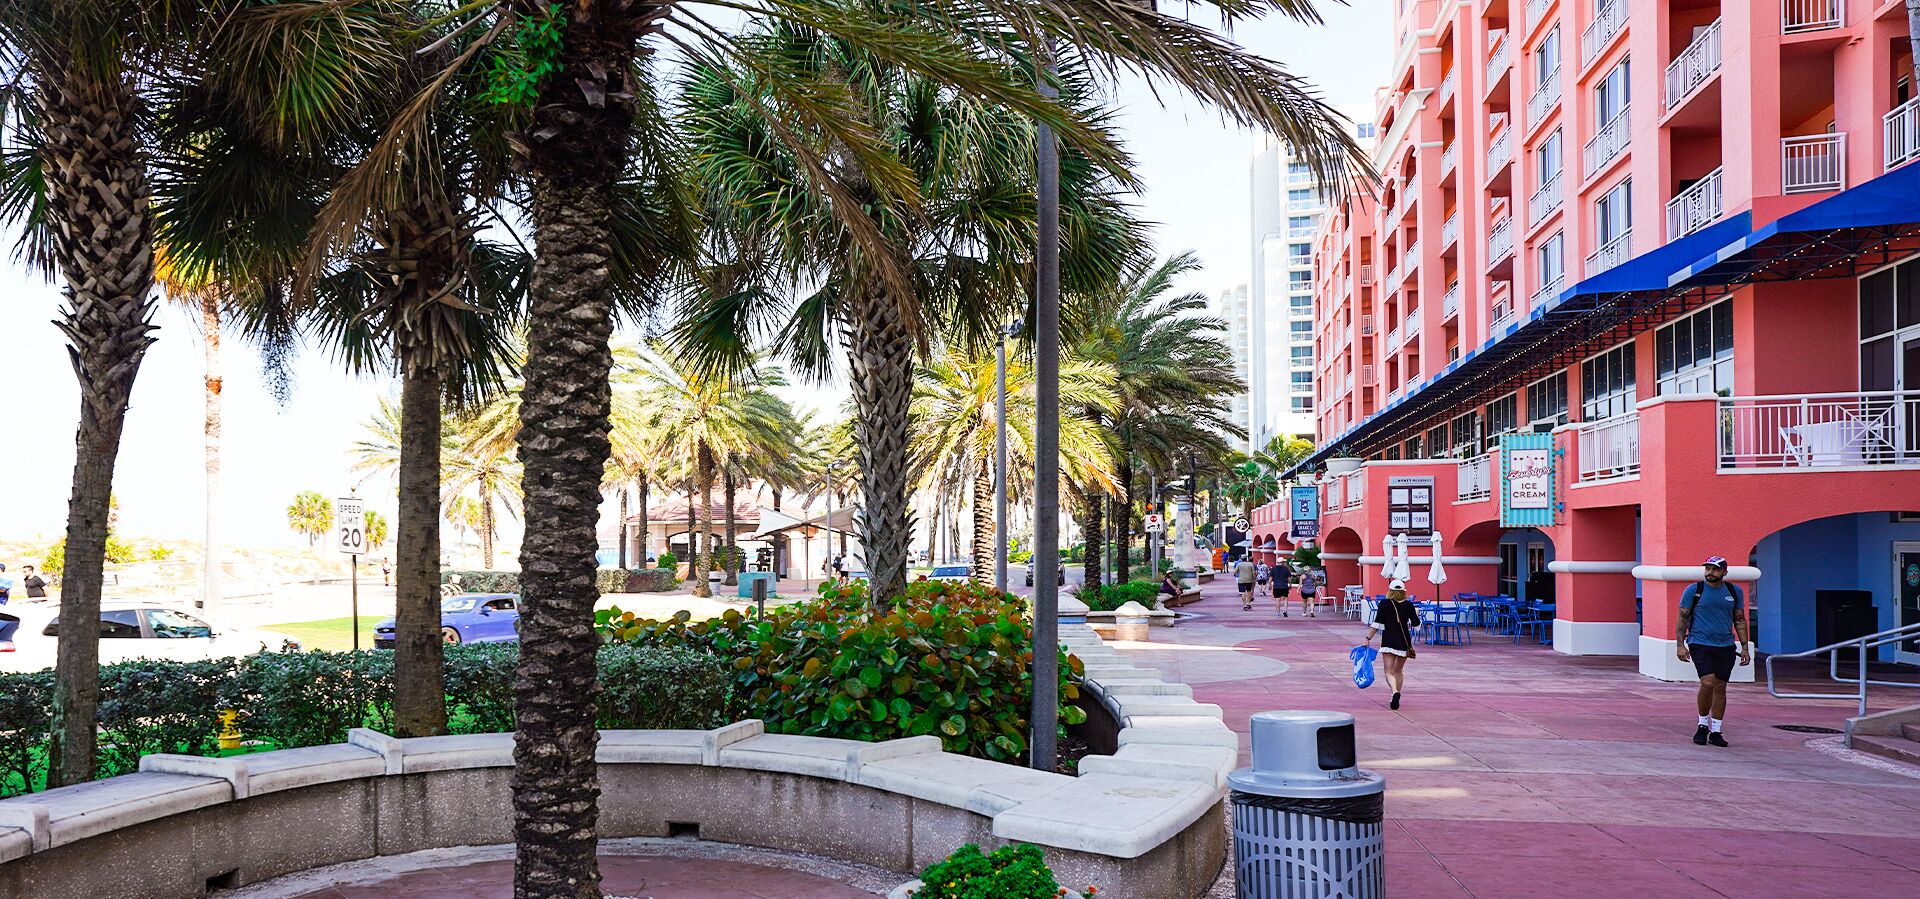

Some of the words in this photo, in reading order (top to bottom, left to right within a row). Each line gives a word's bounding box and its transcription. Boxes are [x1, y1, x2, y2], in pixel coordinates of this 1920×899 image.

[1521, 482, 1538, 490] ICE
[1512, 491, 1547, 499] CREAM
[339, 504, 362, 514] SPEED
[341, 516, 360, 525] LIMIT
[341, 527, 362, 548] 20
